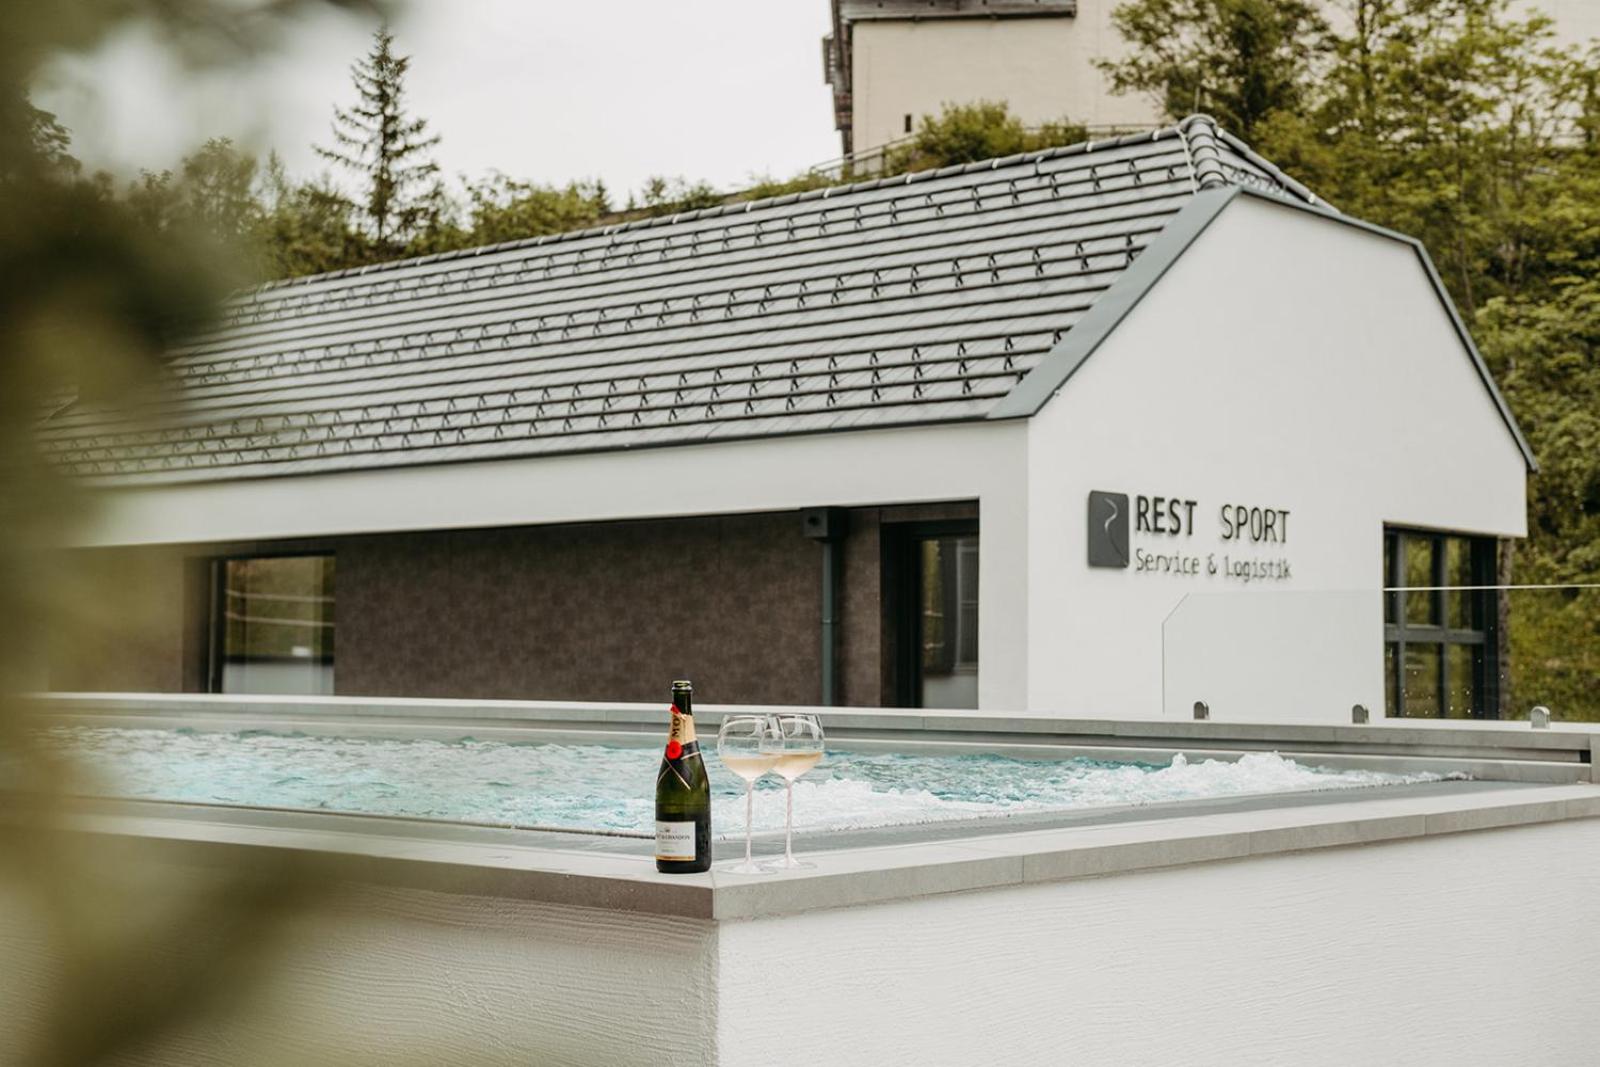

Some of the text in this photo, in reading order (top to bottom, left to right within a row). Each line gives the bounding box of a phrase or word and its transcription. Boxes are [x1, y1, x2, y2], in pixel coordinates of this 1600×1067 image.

[1136, 494, 1290, 543] REST SPORT
[1136, 547, 1292, 583] Service & Logistik
